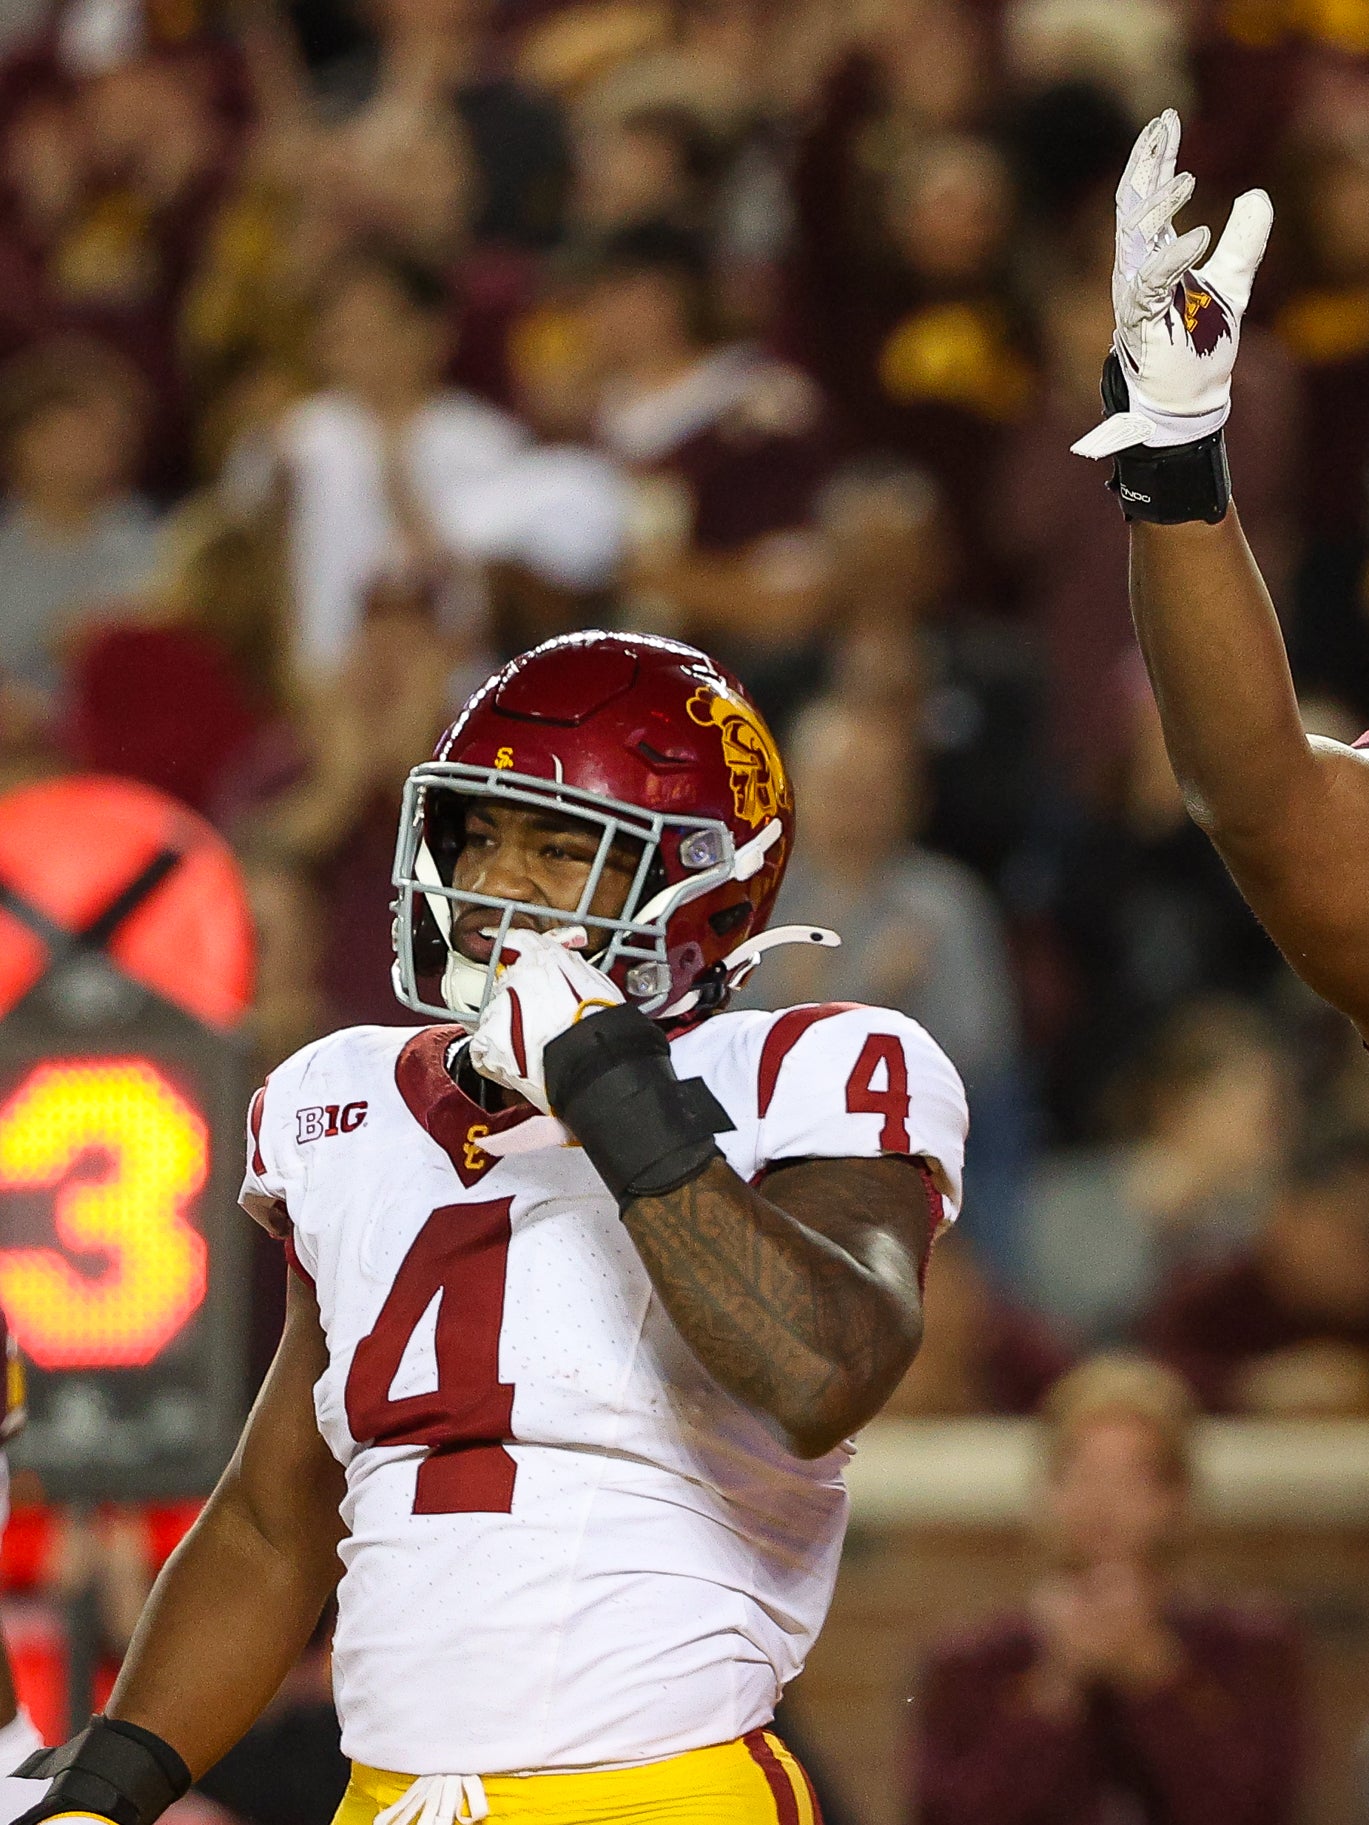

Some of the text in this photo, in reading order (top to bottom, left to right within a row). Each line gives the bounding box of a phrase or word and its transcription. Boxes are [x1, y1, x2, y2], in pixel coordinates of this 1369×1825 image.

[295, 1100, 369, 1145] BIG
[845, 1032, 912, 1153] 4
[0, 1057, 210, 1372] 3
[344, 1195, 518, 1515] 4
